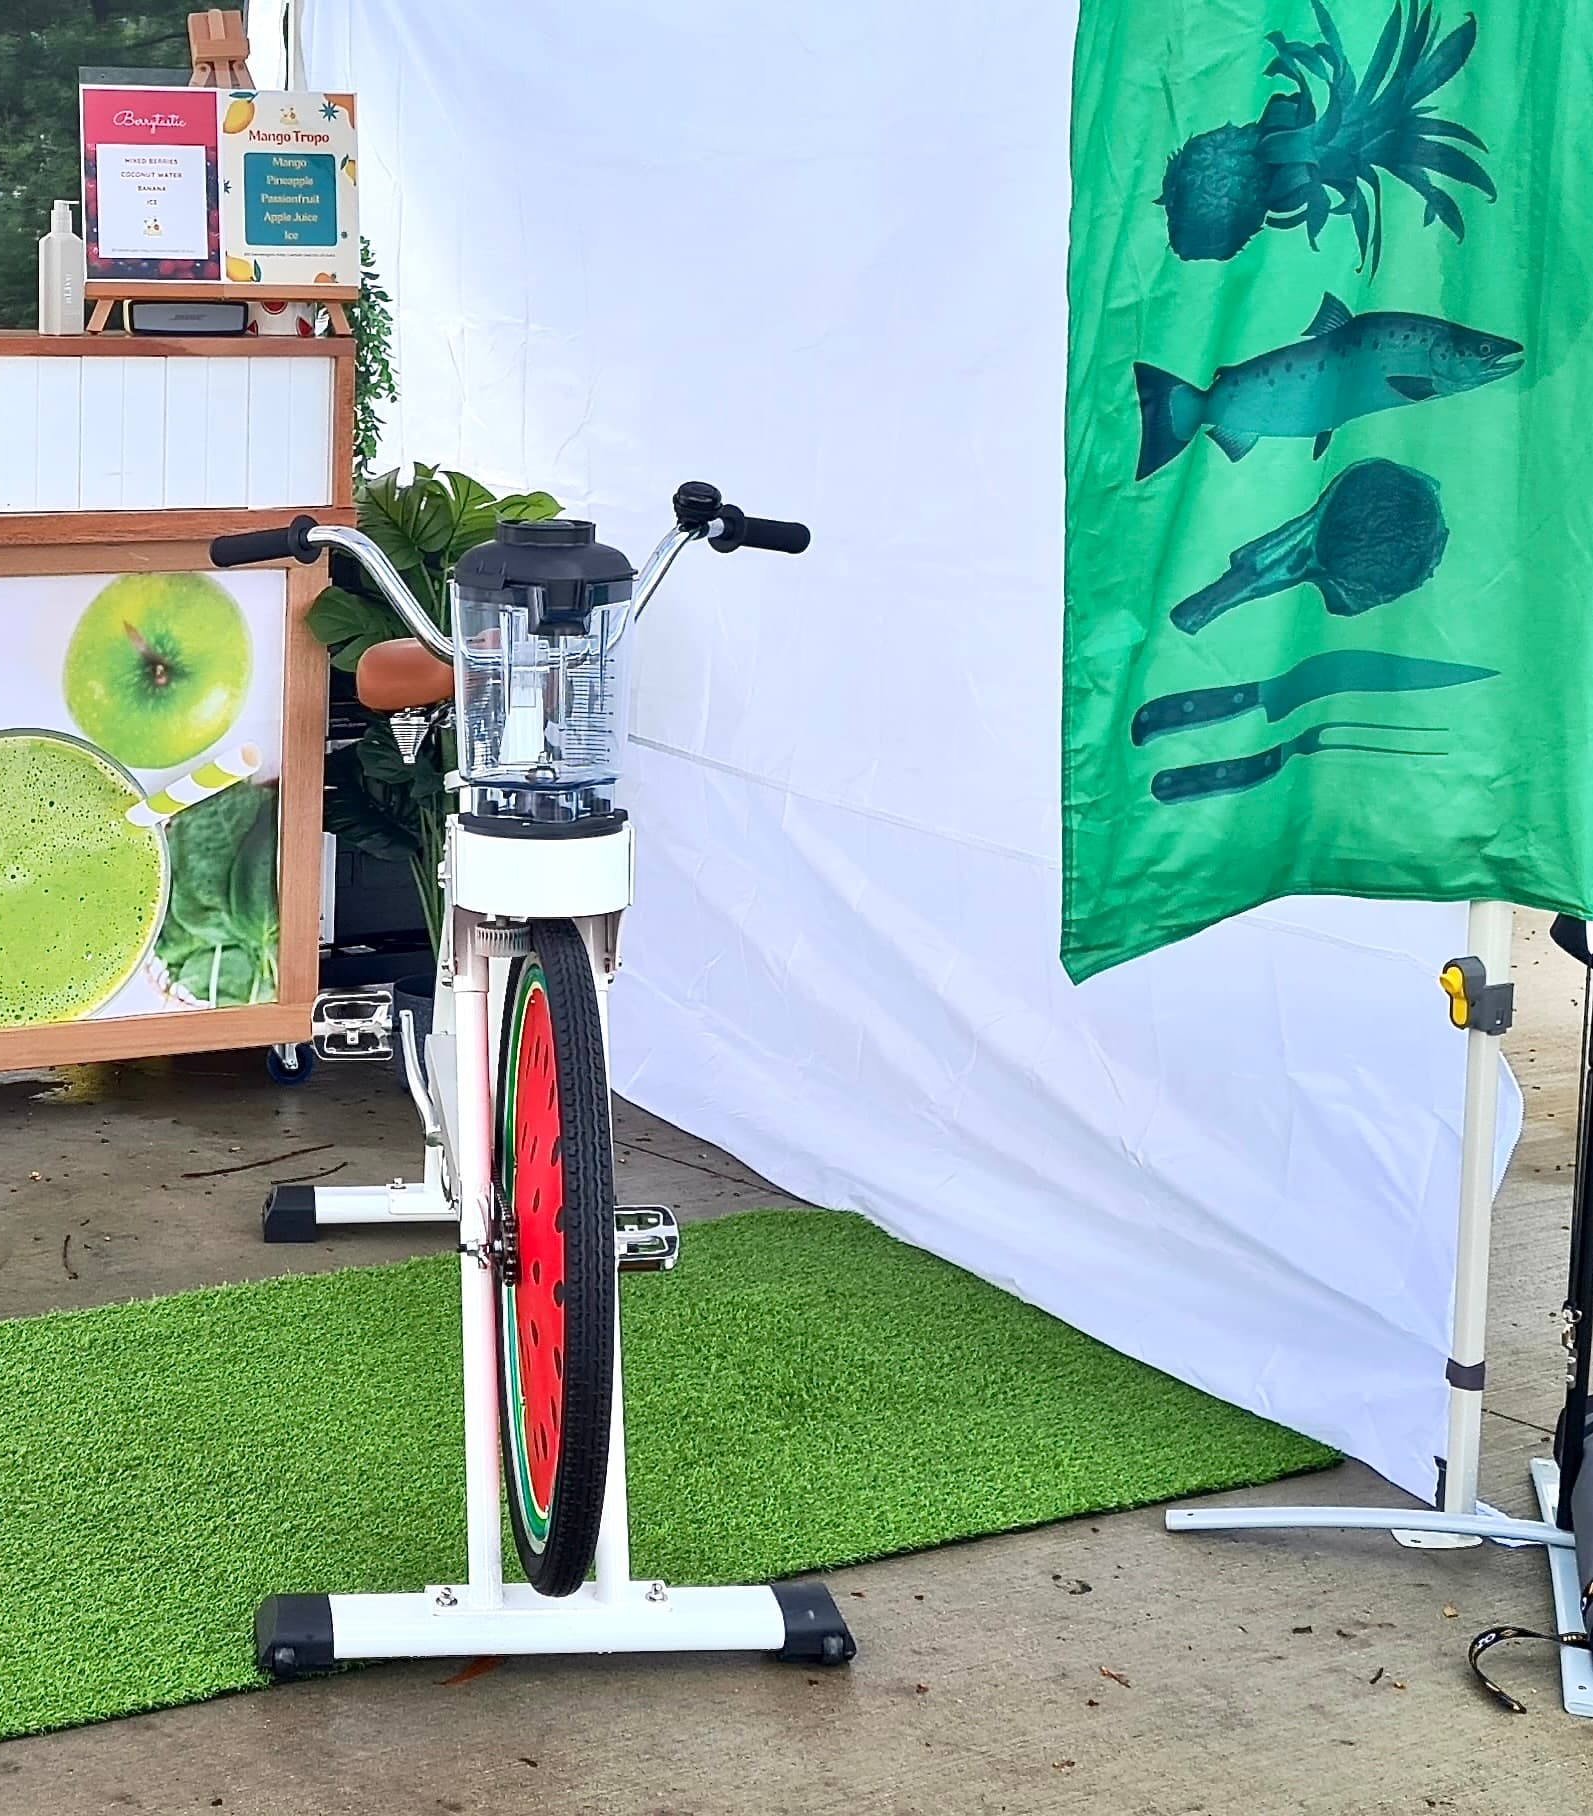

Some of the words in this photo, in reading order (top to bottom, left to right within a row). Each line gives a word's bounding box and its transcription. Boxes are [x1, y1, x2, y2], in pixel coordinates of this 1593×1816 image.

[249, 130, 291, 145] Mango
[293, 130, 330, 145] Tropo
[272, 157, 307, 169] Mango
[266, 175, 313, 188] Pineapple
[261, 193, 320, 204] Passionfruit
[264, 211, 292, 224] Apple
[293, 212, 318, 223] Juice
[283, 230, 299, 241] Ice
